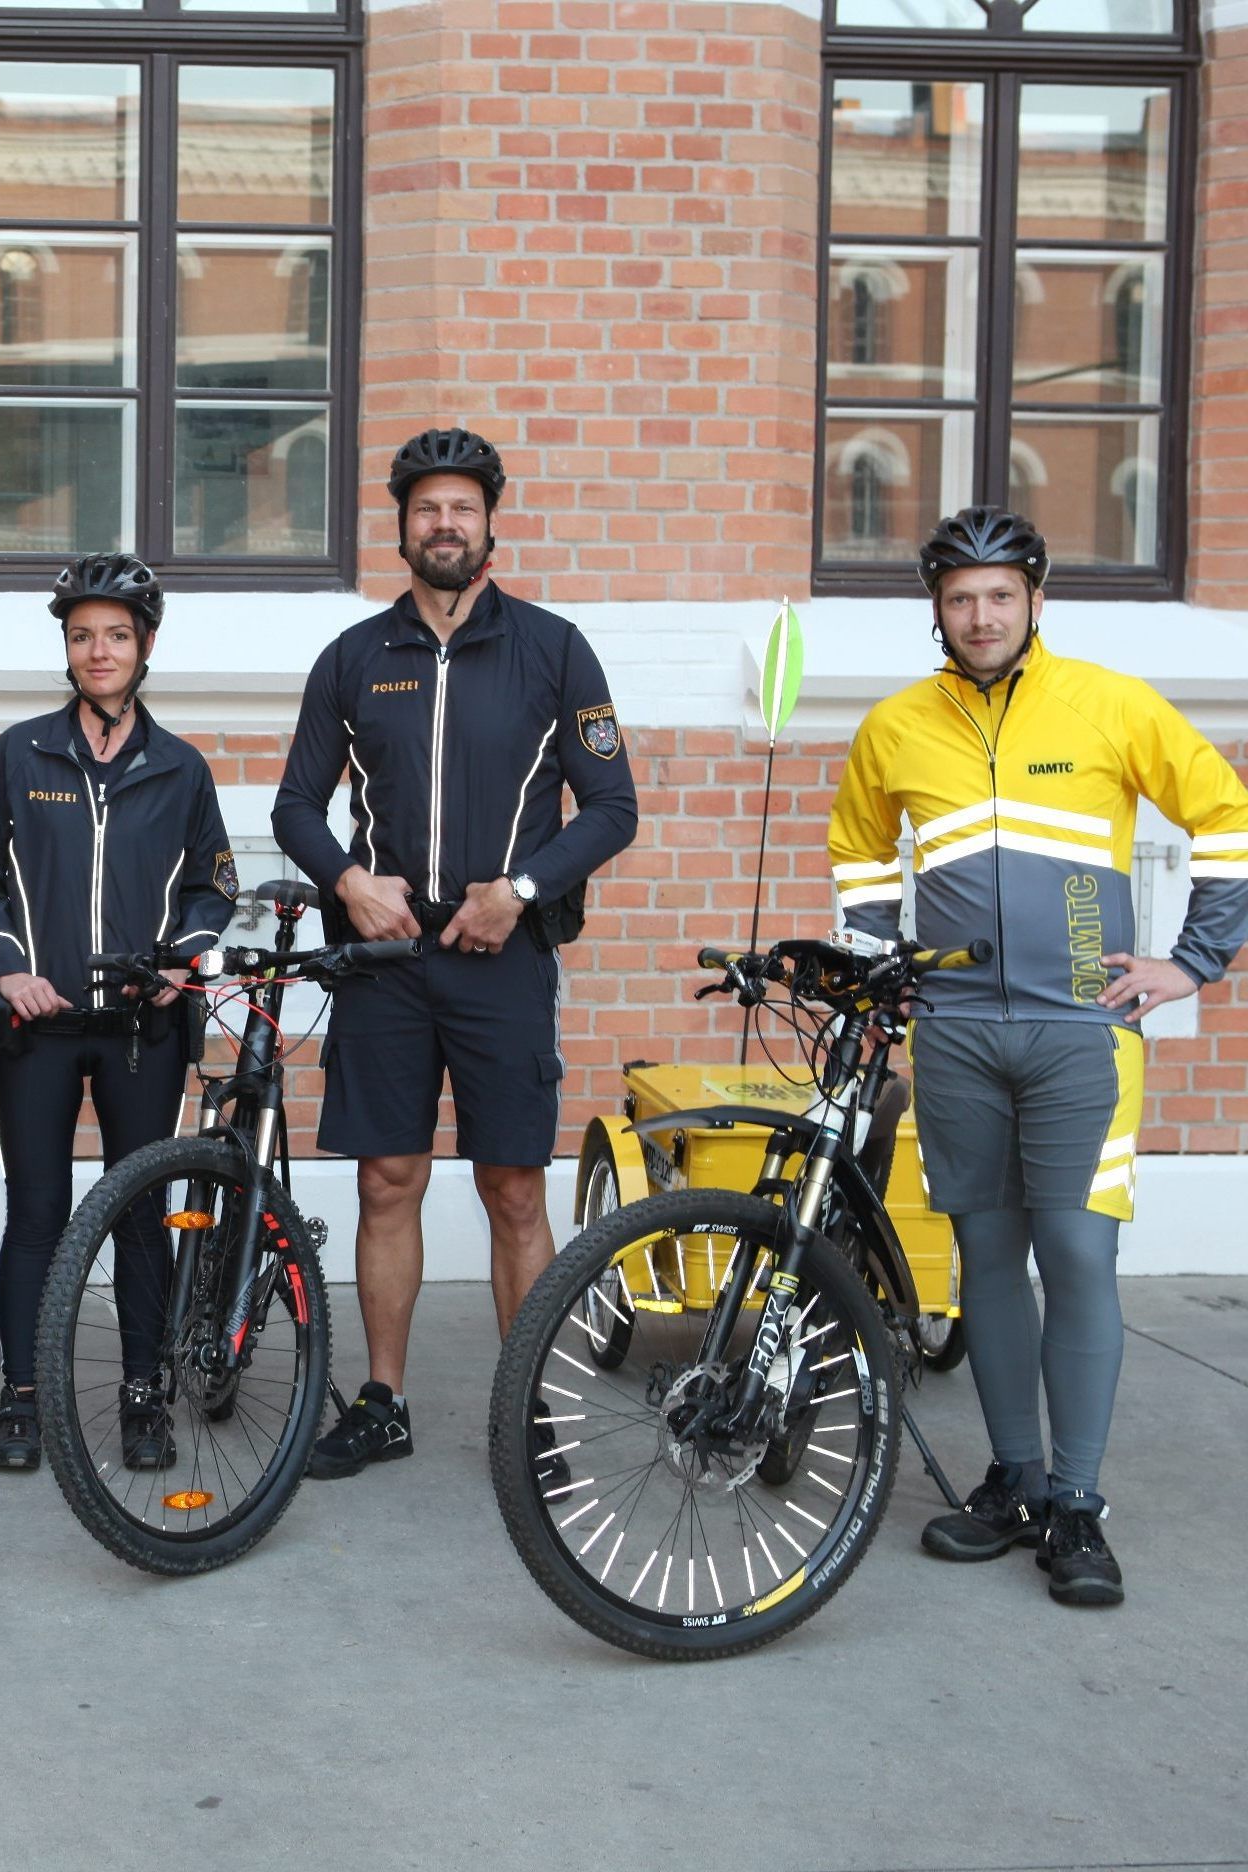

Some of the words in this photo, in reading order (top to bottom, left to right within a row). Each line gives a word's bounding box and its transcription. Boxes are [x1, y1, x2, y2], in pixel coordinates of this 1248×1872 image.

[372, 680, 419, 693] POLIZEI
[29, 790, 77, 802] POLIZEI
[1064, 874, 1108, 1003] ÖAMTC
[692, 1223, 710, 1233] DT
[710, 1223, 739, 1235] SWISS
[748, 1293, 788, 1384] FOX
[811, 1516, 863, 1589] RACING
[859, 1430, 888, 1514] RALPH
[682, 1616, 709, 1627] SWISS
[711, 1613, 727, 1626] DT
